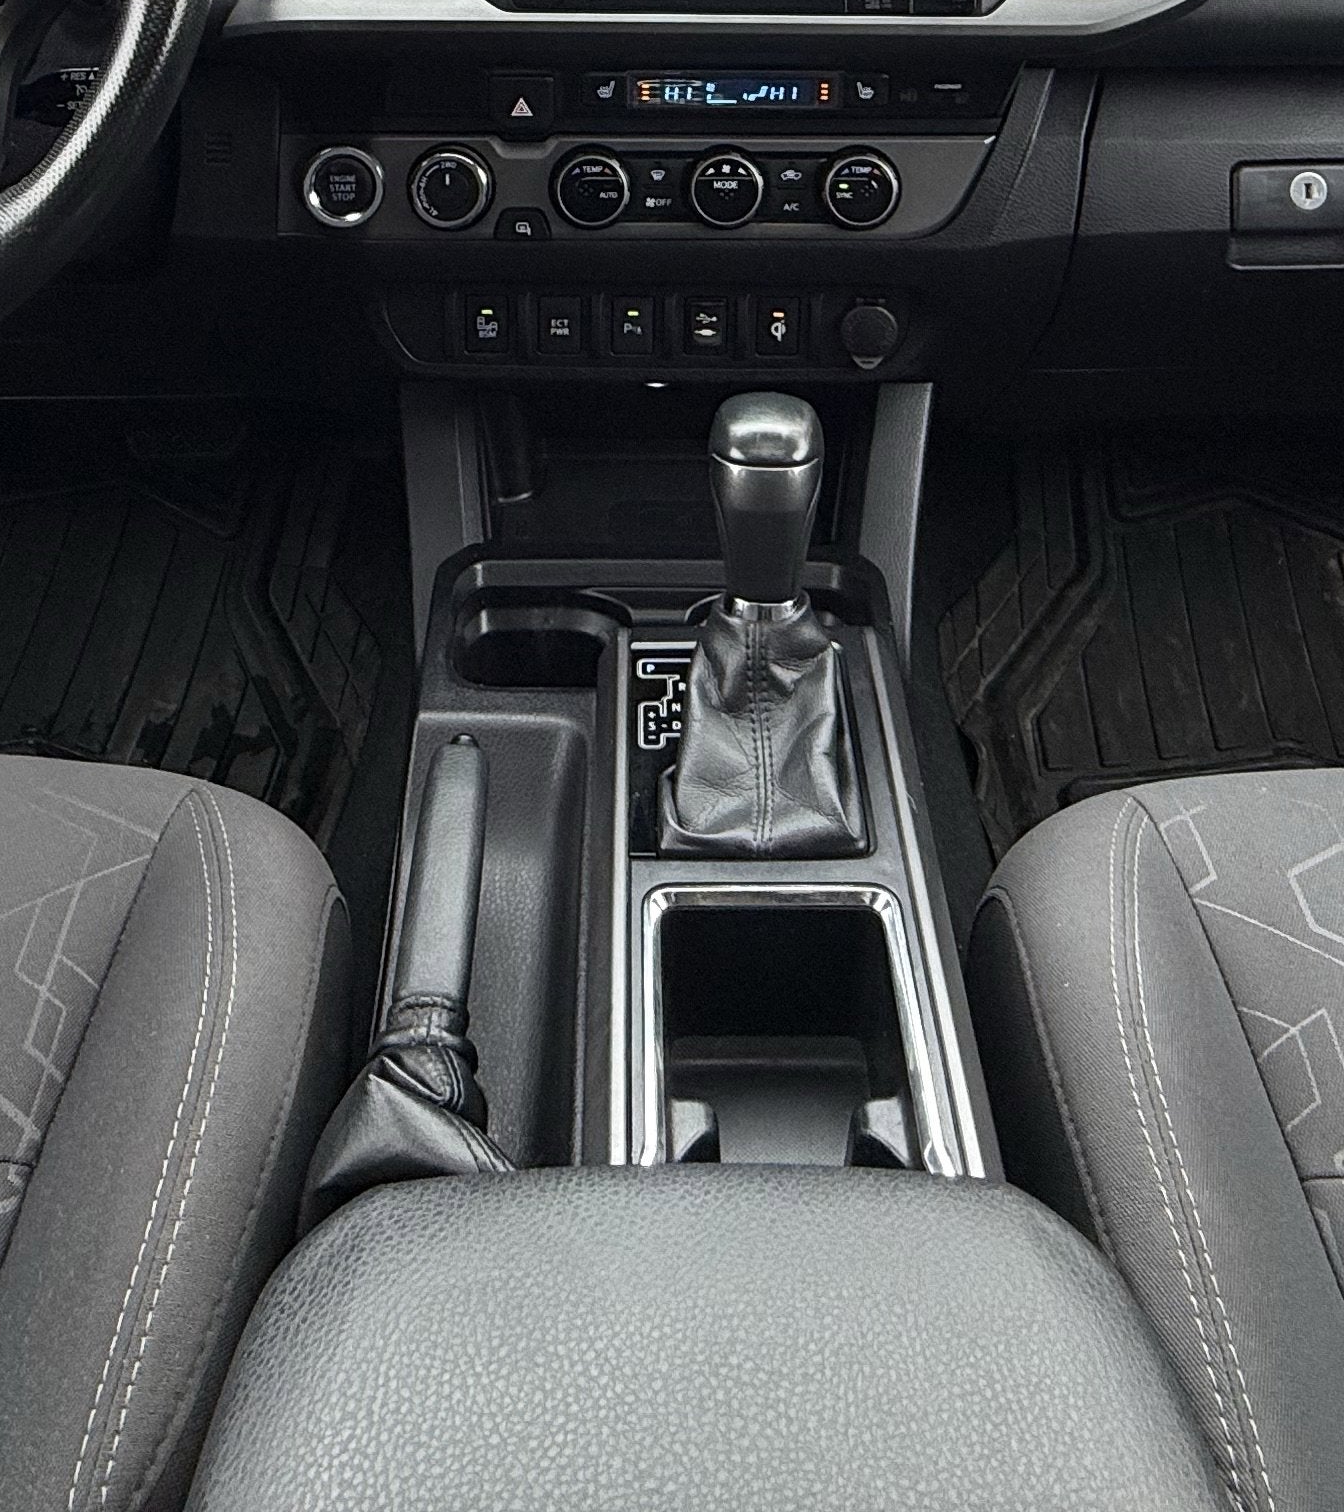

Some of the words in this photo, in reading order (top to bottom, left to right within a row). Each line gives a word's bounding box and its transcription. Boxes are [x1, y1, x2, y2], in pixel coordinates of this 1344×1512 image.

[769, 86, 798, 100] HI
[440, 161, 458, 169] 2WD
[582, 165, 604, 173] TEMP
[851, 166, 872, 174] TEMP
[330, 174, 357, 183] ENGINE
[330, 183, 357, 192] START
[713, 180, 739, 189] MODE
[331, 193, 356, 201] STOP
[599, 191, 618, 199] AUTO
[835, 191, 854, 200] SYNC
[655, 197, 673, 207] OFF
[783, 202, 800, 212] A/C
[550, 318, 569, 327] ECT
[549, 327, 570, 336] PWR
[646, 663, 655, 673] P
[678, 681, 687, 692] R
[671, 702, 682, 712] N
[647, 721, 657, 731] S
[671, 720, 682, 730] D
